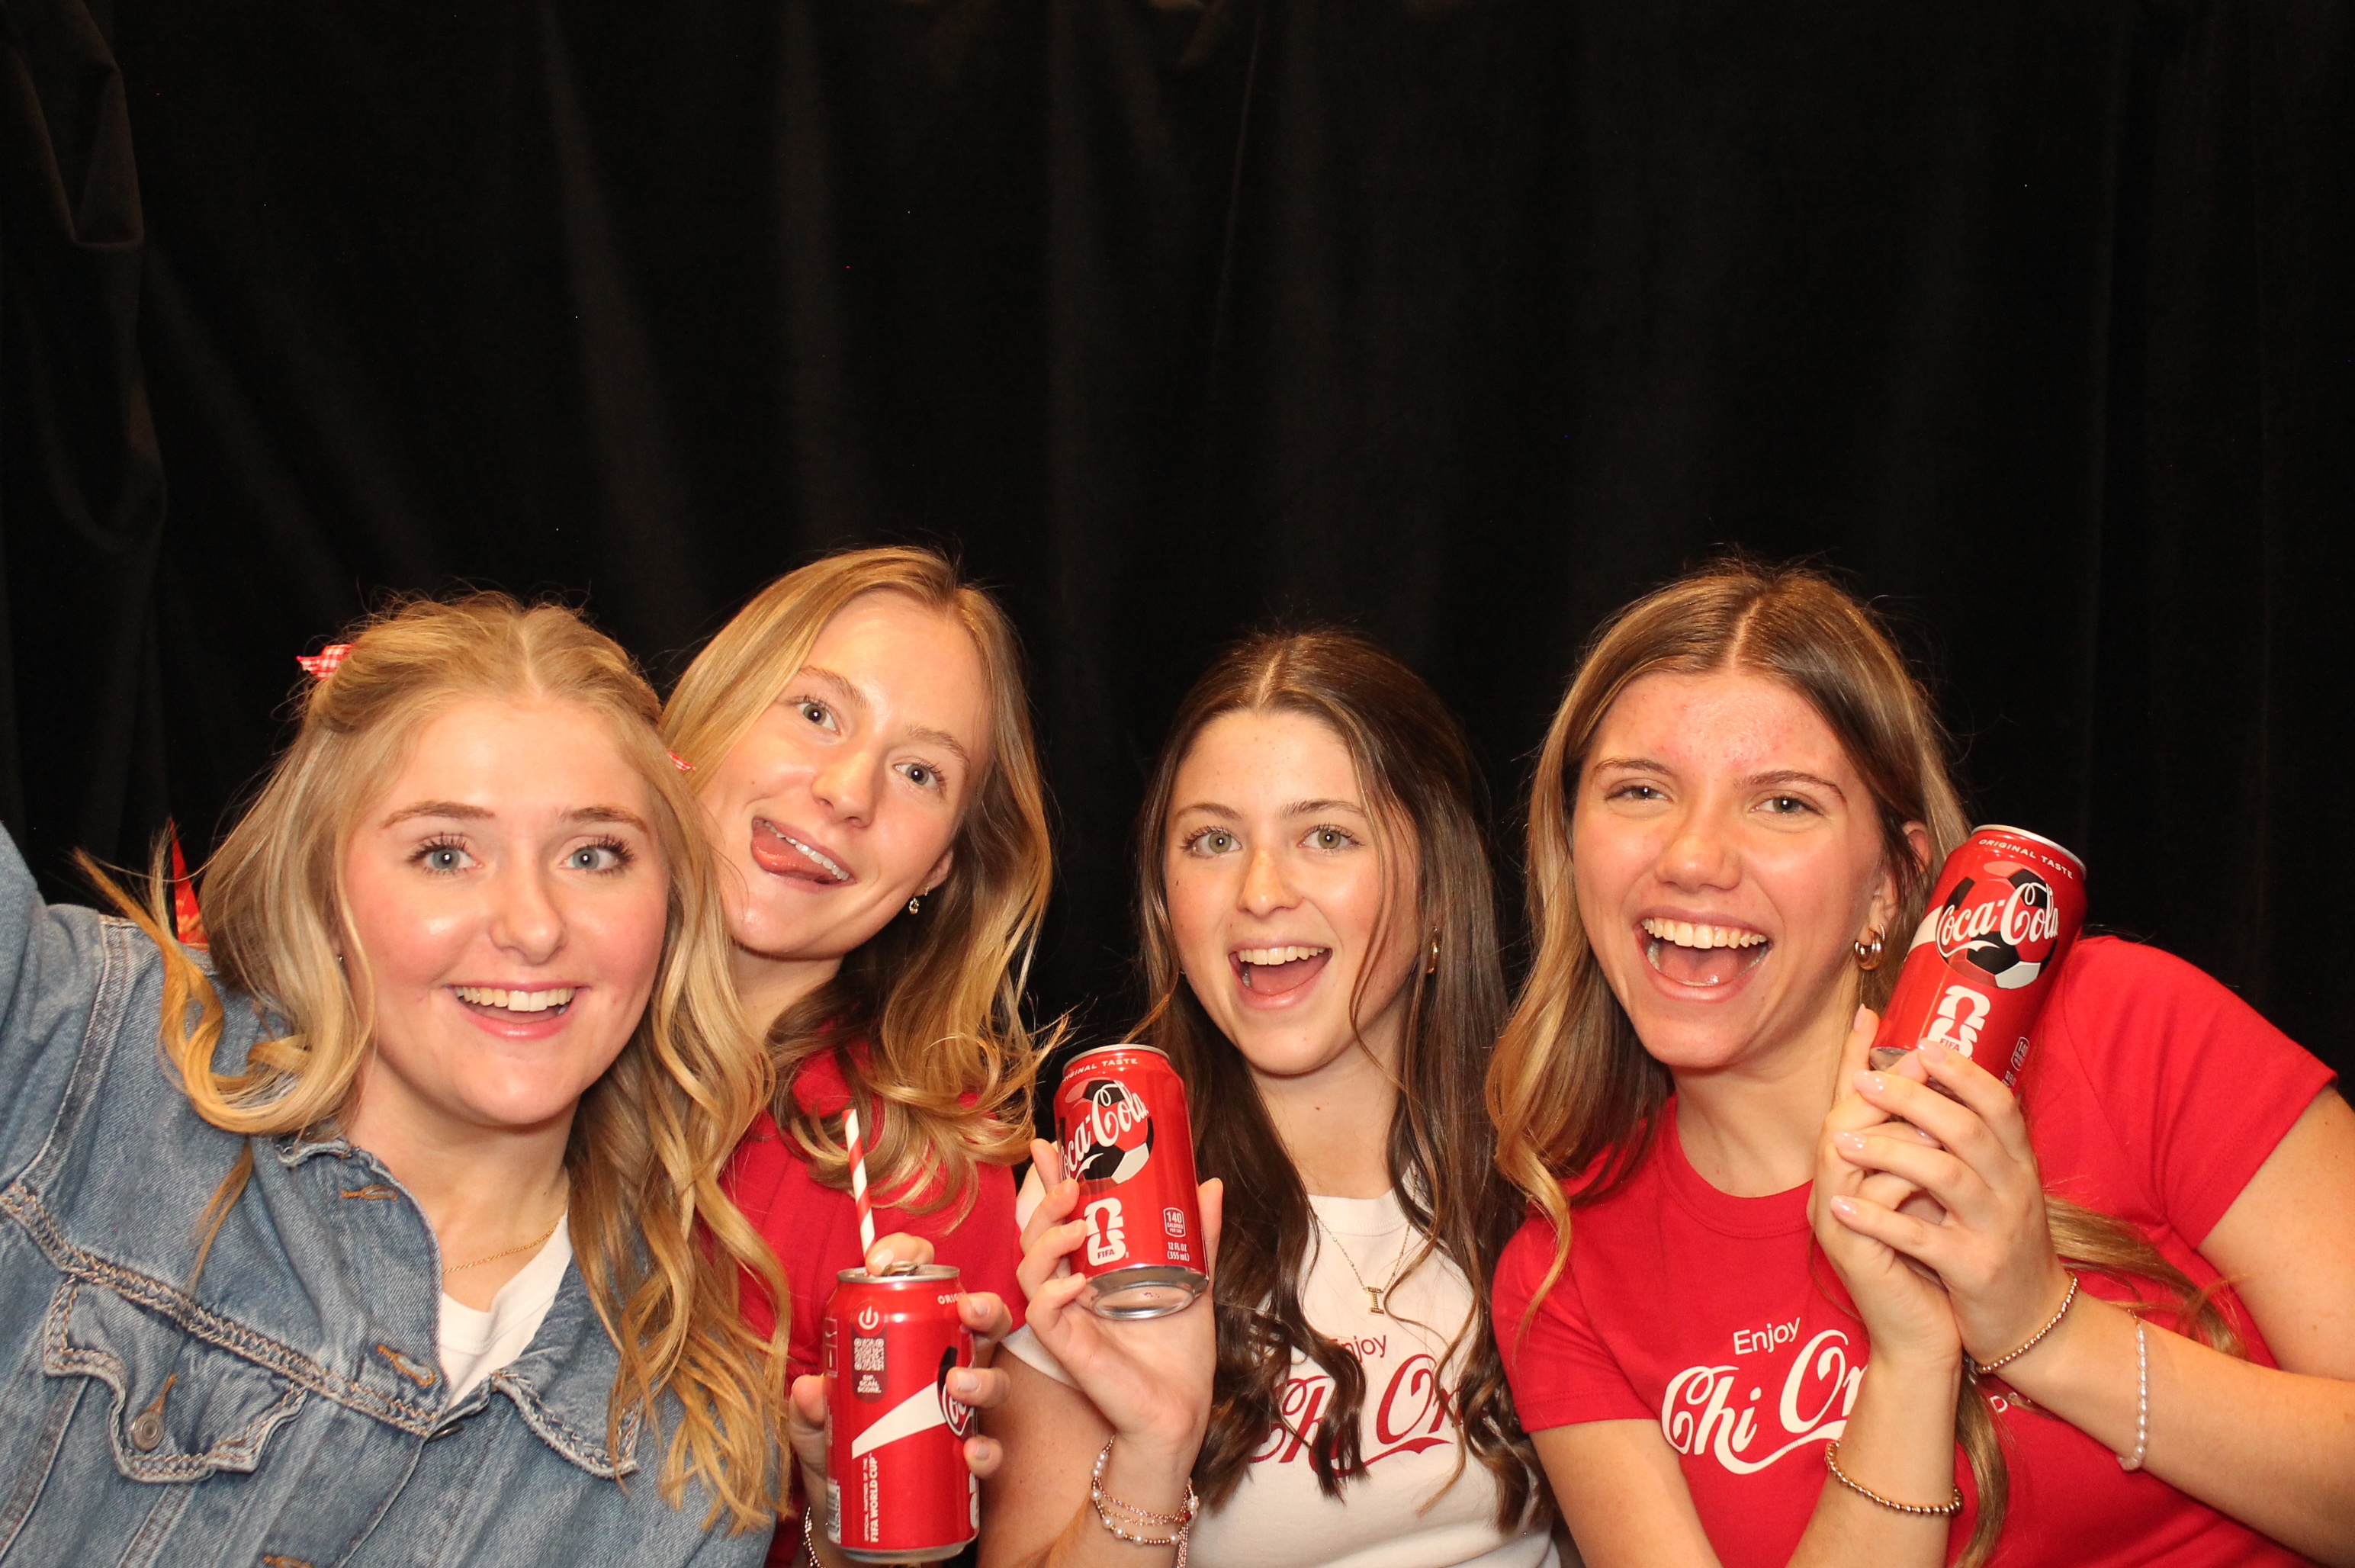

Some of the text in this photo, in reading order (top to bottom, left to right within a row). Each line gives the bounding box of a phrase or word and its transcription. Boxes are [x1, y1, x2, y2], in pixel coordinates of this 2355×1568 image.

[1978, 839, 2073, 879] ORIGINAL TASTE
[1936, 882, 2058, 957] Coca-Cola
[1939, 1038, 1960, 1052] FIFA
[1062, 1058, 1138, 1081] RIGINAL TASTE
[1167, 1211, 1183, 1223] 140
[1097, 1248, 1115, 1259] FIFA
[1167, 1250, 1180, 1260] (355
[1168, 1242, 1187, 1252] 12 FL OZ
[1733, 1317, 1800, 1354] Enjoy
[1661, 1364, 1763, 1474] Chi
[869, 1480, 879, 1519] WORLD
[870, 1518, 879, 1543] FIFA
